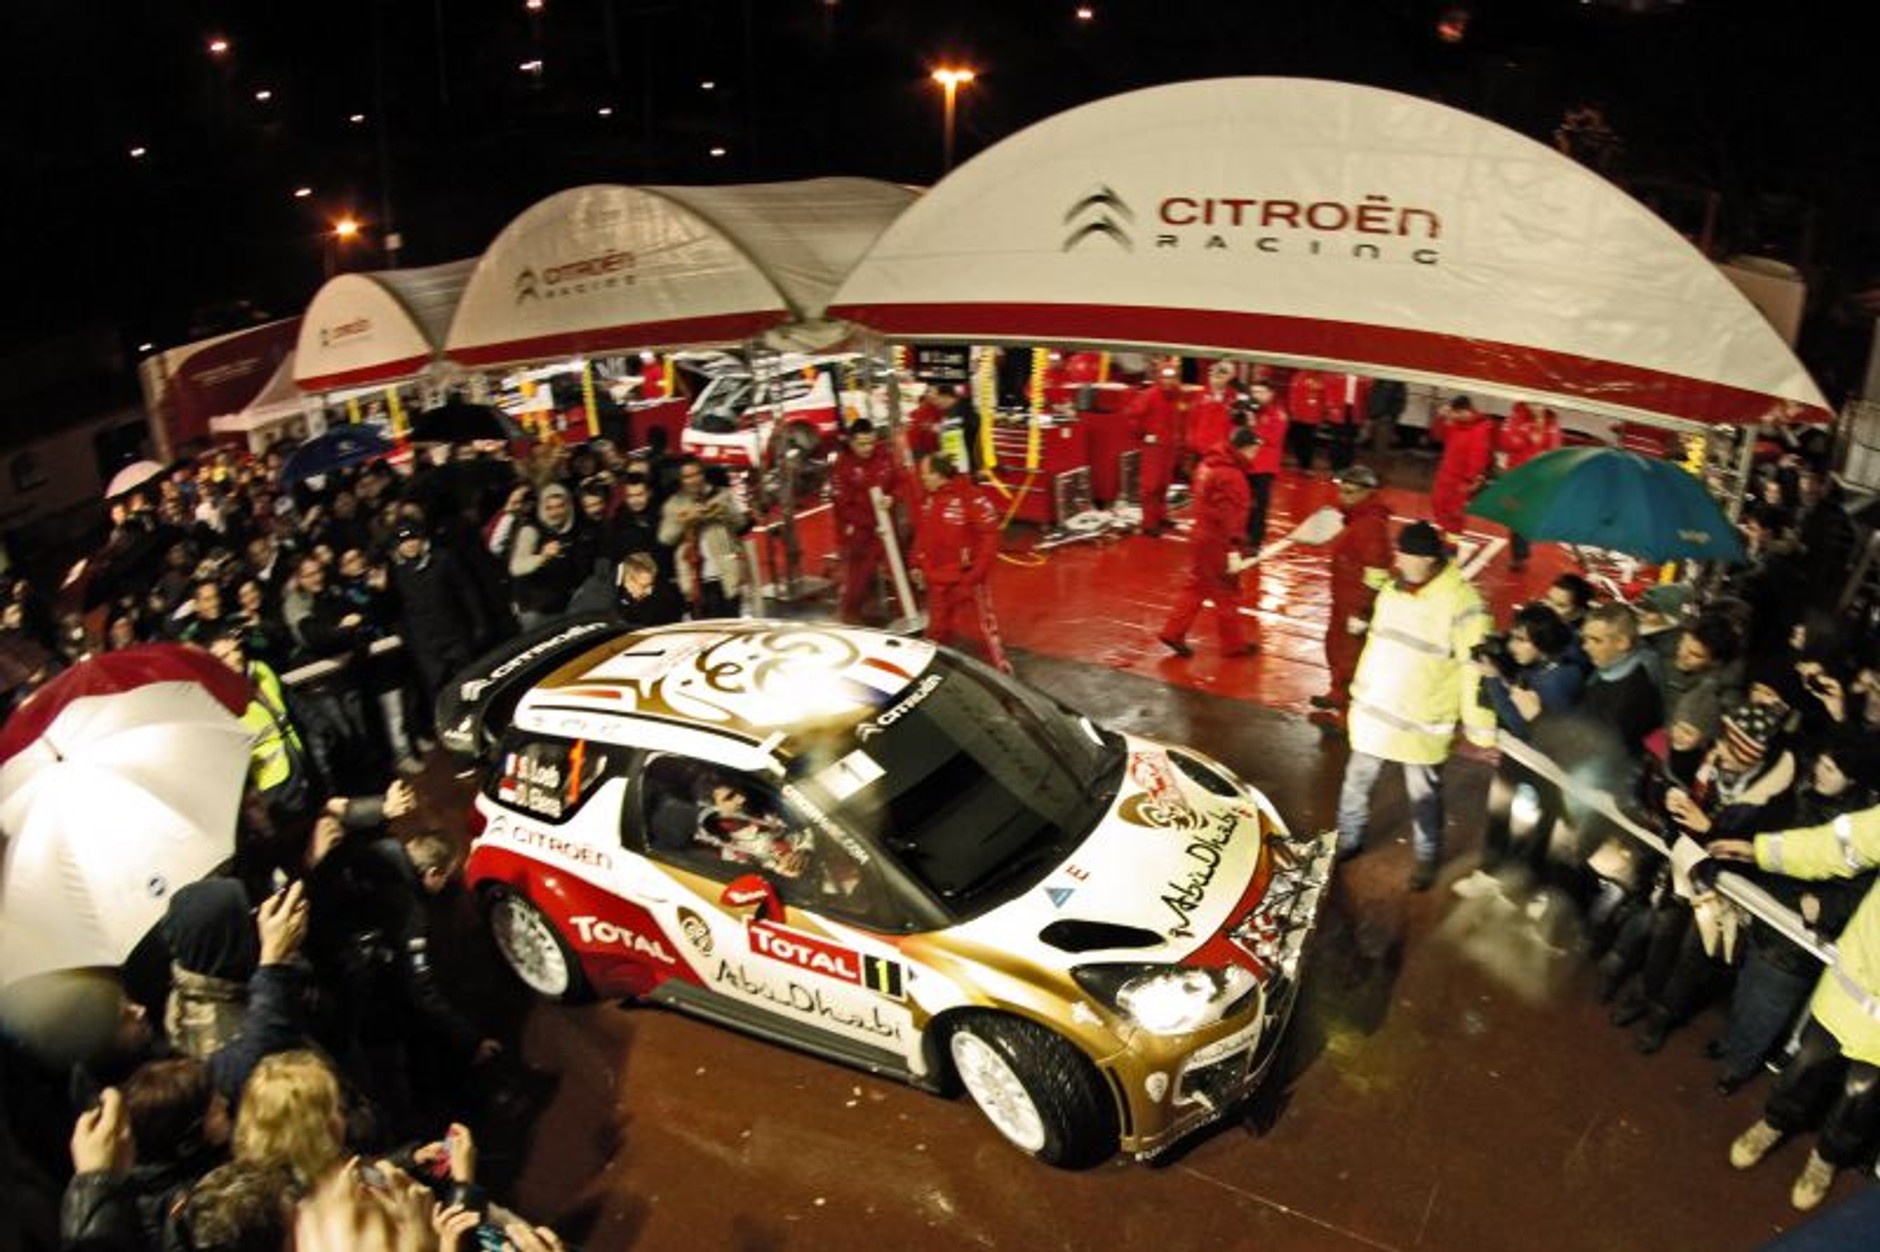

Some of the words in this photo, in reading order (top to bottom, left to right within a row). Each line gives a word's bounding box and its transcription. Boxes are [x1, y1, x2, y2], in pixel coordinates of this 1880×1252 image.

[1156, 234, 1439, 265] RACING
[569, 916, 676, 965] TOTAL
[751, 925, 858, 979] TOTAL
[875, 959, 891, 996] 1
